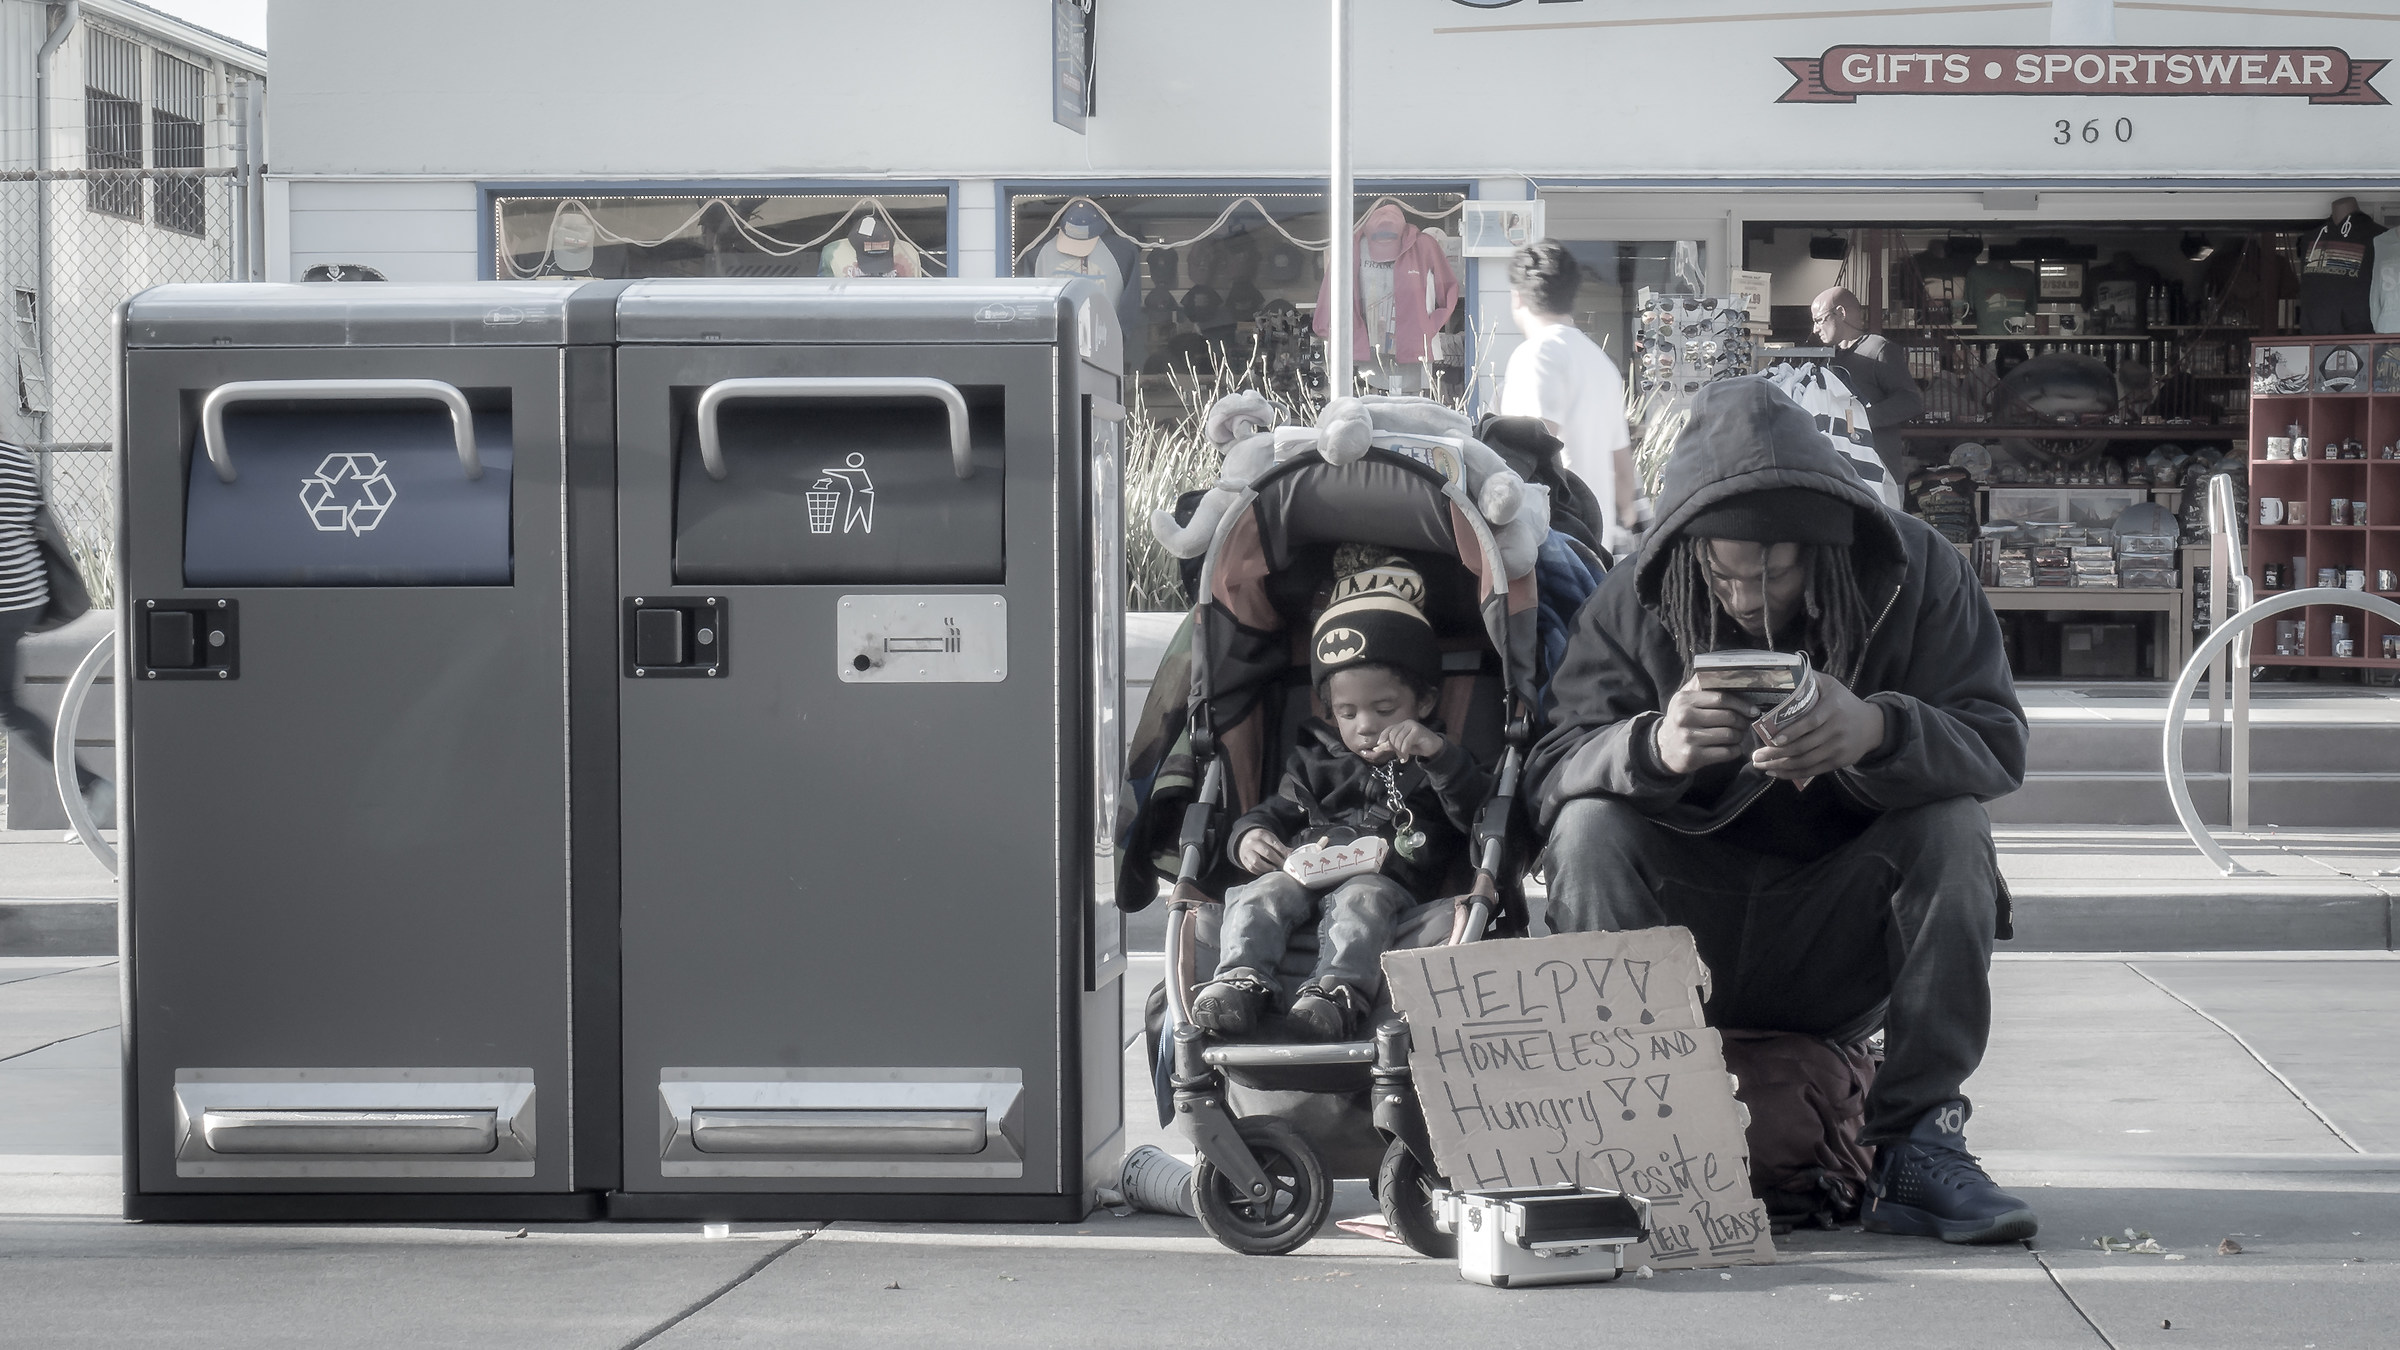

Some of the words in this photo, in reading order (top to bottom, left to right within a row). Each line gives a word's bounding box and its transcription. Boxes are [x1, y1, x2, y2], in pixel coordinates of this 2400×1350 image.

[1841, 53, 1970, 84] GIFTS
[2014, 53, 2333, 86] SPORTSWEAR
[2053, 117, 2134, 146] 360
[1431, 1026, 1645, 1078] HOMELESS
[1650, 1031, 1698, 1061] AND
[1650, 1211, 1695, 1255] HELP
[1688, 1200, 1766, 1250] PLEASE
